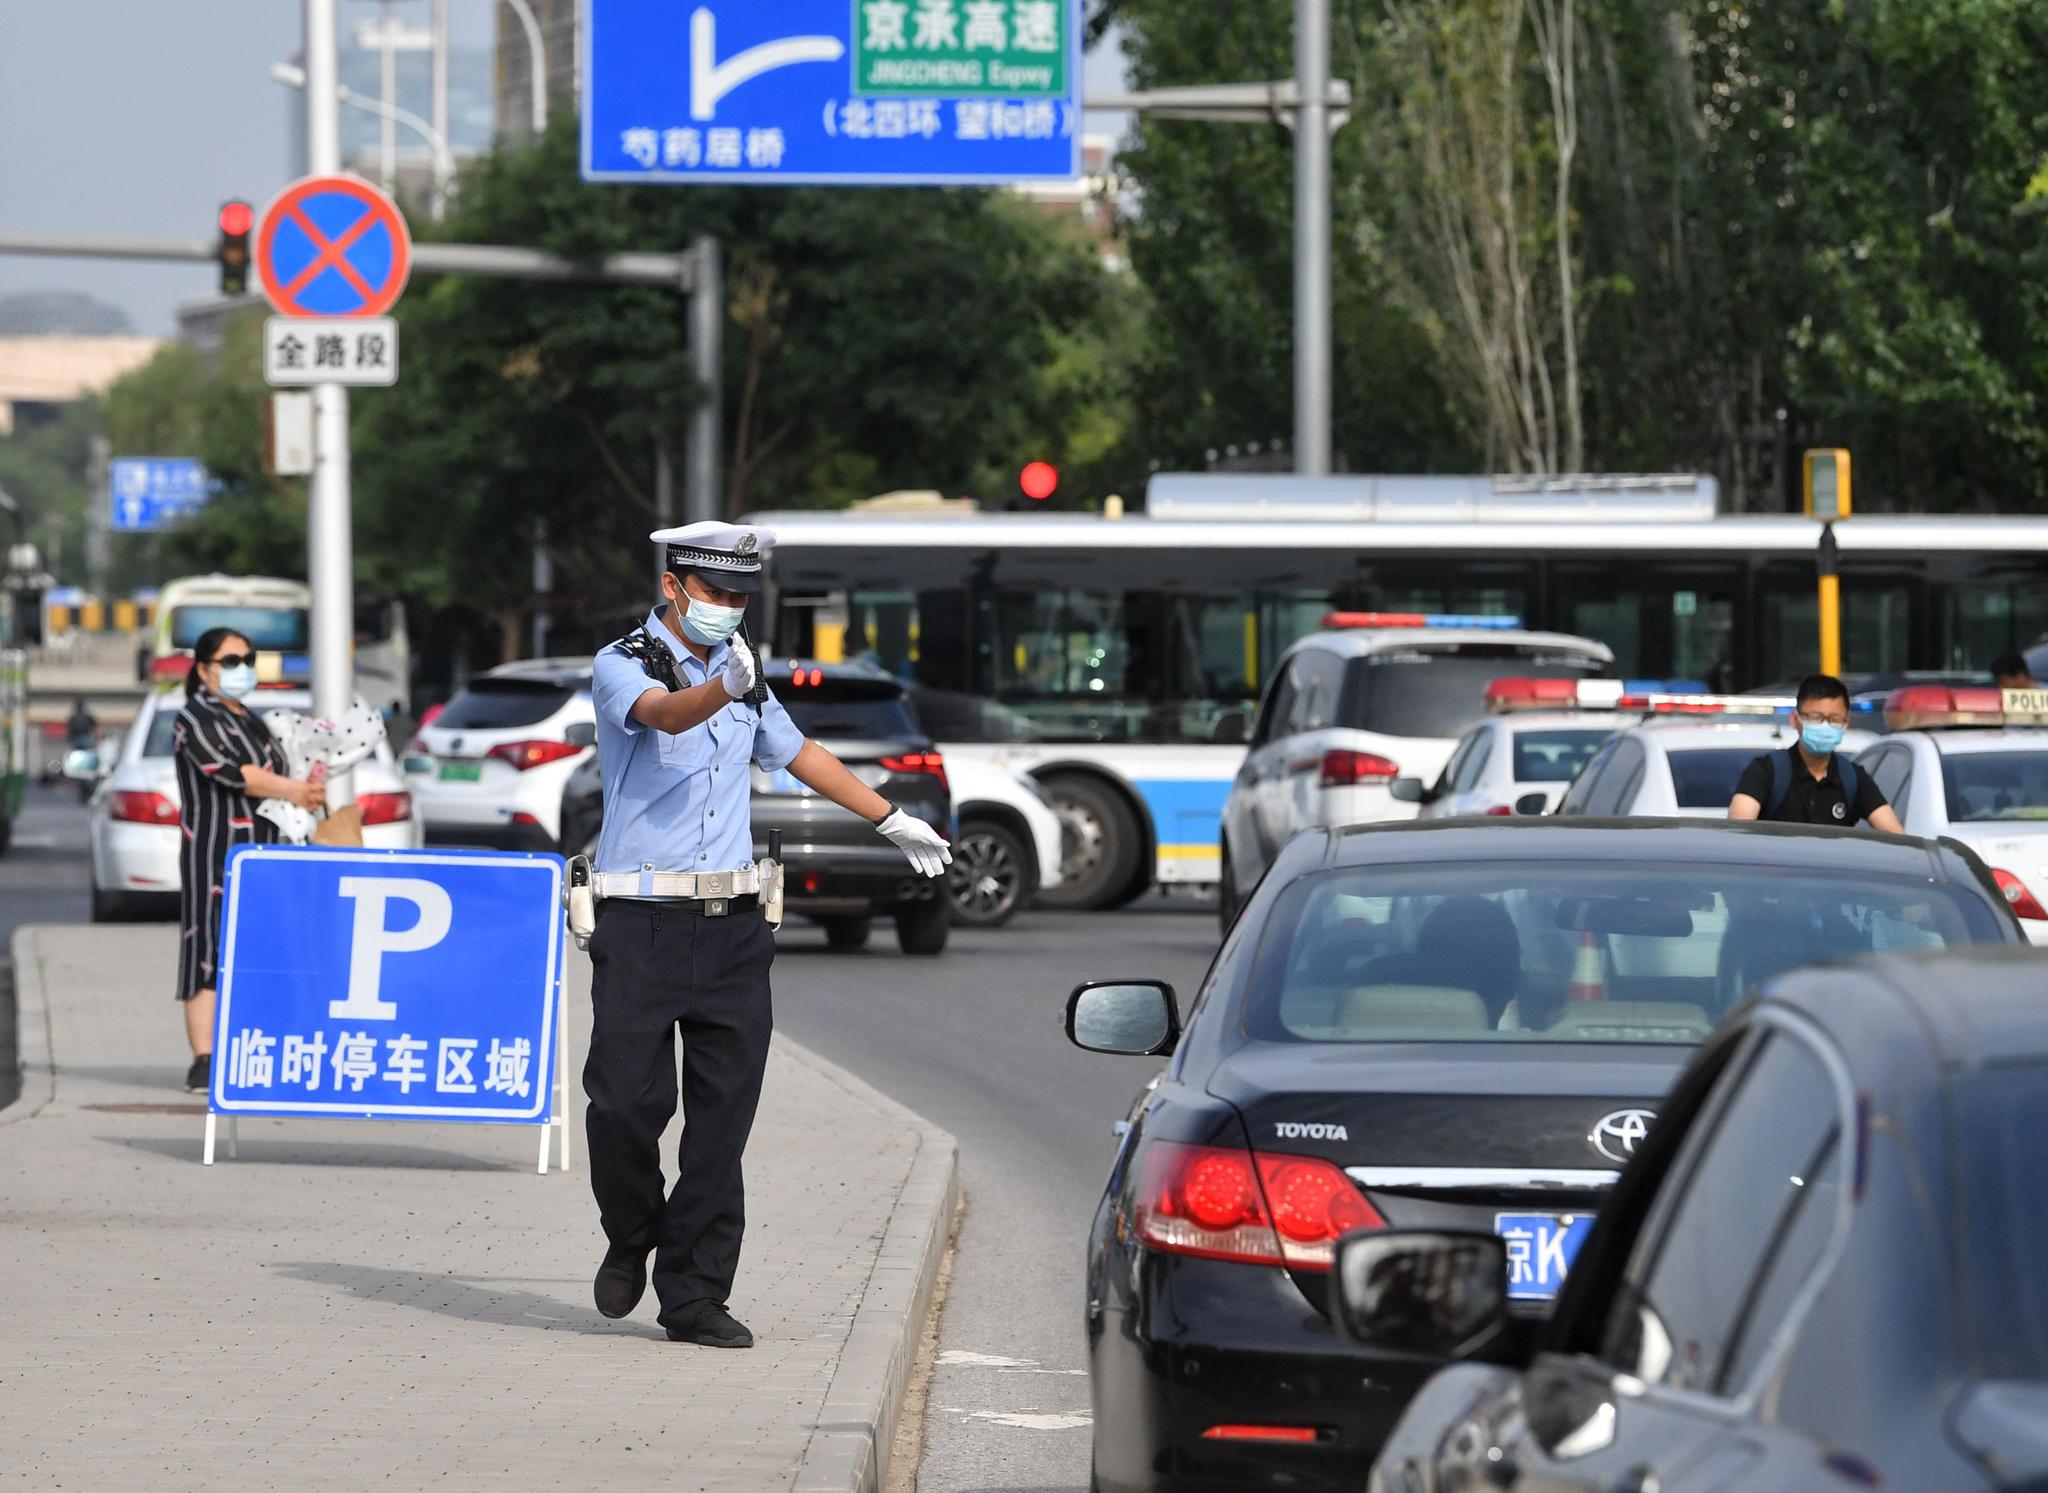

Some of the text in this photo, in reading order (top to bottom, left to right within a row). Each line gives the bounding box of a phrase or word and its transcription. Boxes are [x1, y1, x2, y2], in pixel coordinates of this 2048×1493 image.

[863, 0, 1058, 52] 京承高速
[868, 59, 1053, 90] JINGCHENG Expwy
[620, 126, 785, 168] 芍药居桥
[276, 332, 385, 368] 全路段
[2010, 693, 2048, 709] POLI
[328, 876, 453, 1021] P
[228, 1028, 531, 1098] 临时停车区域
[1275, 1122, 1348, 1141] TOYOTA
